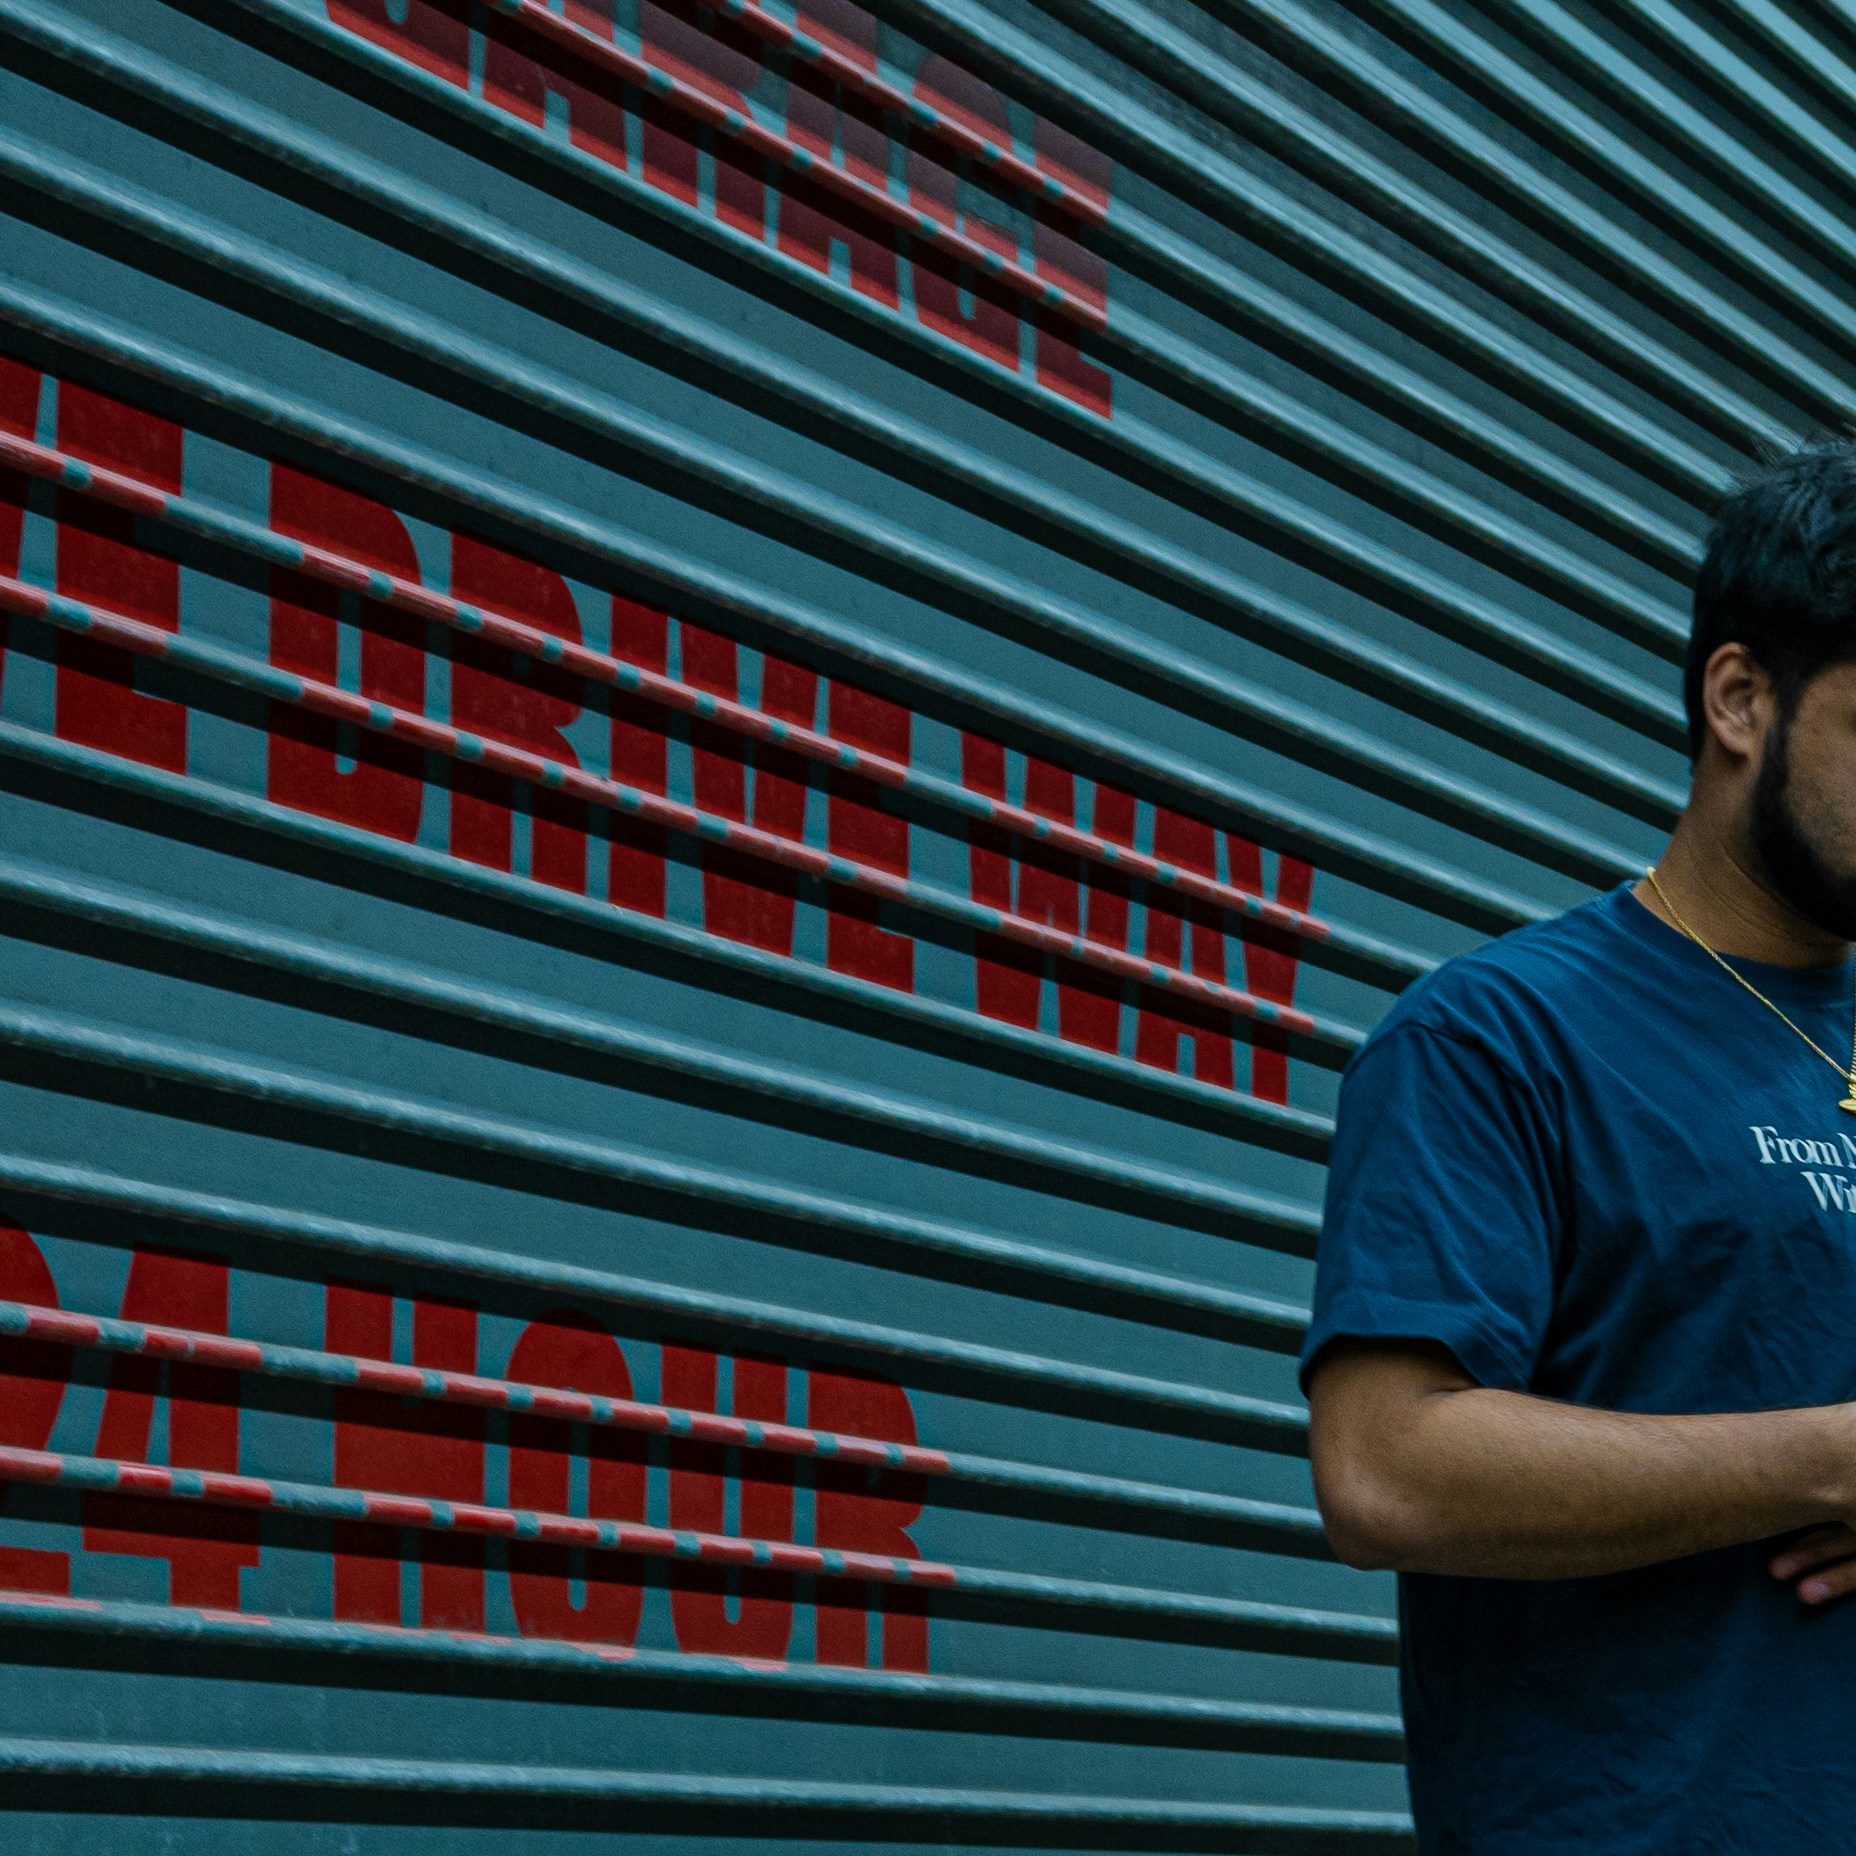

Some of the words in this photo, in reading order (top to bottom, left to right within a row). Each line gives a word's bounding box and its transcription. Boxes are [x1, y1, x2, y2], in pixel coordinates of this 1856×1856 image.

[325, 0, 1112, 421] ARAGE
[268, 458, 915, 996] DRIVE
[960, 727, 1328, 1107] WAY
[1748, 1125, 1843, 1167] From
[325, 1275, 957, 1677] HOUR
